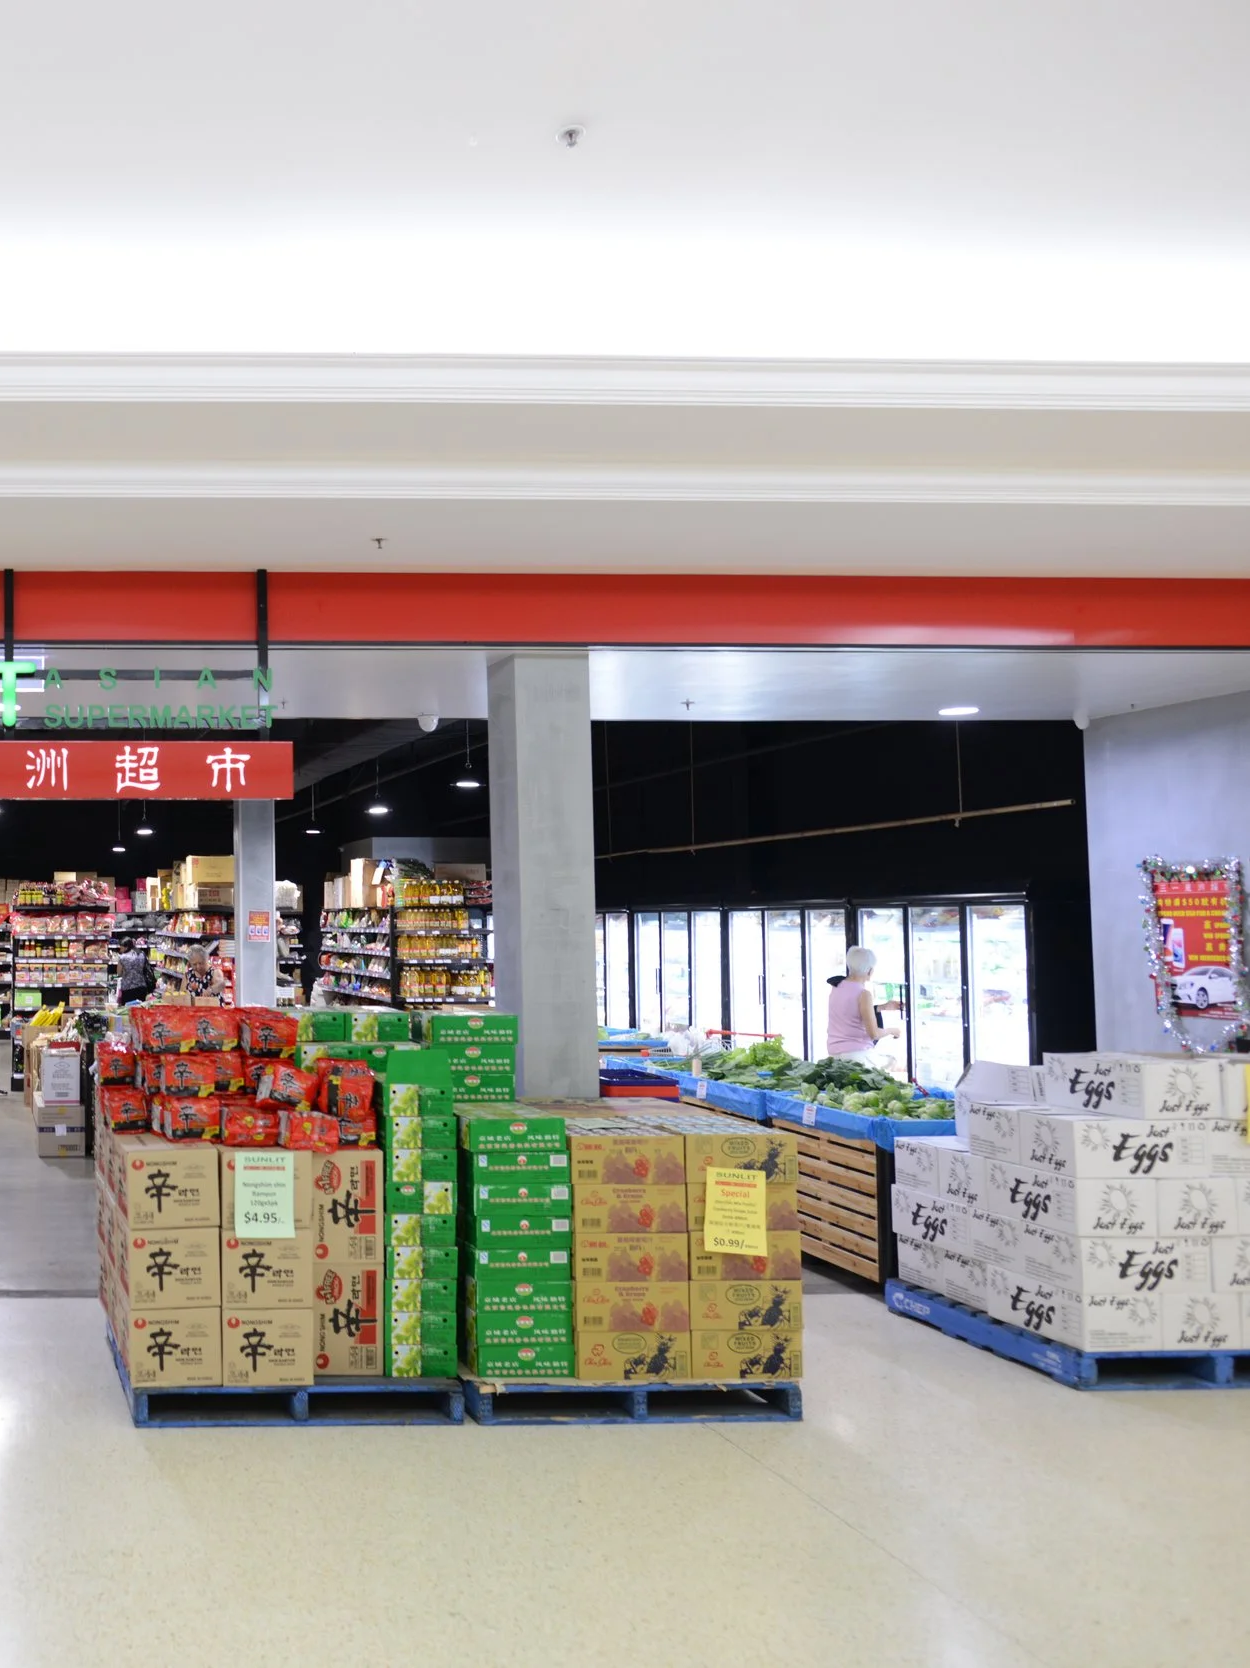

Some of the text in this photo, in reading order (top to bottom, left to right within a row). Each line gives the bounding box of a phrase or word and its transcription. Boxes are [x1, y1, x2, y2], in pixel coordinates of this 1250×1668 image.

[44, 667, 273, 692] ASIAN
[44, 705, 277, 729] SUPERMARKET
[1094, 1063, 1112, 1077] Just
[1070, 1068, 1115, 1109] Eggs
[1159, 1099, 1210, 1117] Just Eggs
[1147, 1124, 1170, 1138] Just
[1212, 1121, 1230, 1132] Just
[1031, 1149, 1066, 1171] Just Eggs
[1113, 1132, 1173, 1174] Eggs
[716, 1171, 758, 1180] SUNLIT
[1032, 1174, 1049, 1188] Just
[145, 1168, 178, 1214] 辛
[721, 1189, 750, 1198] Special
[1010, 1177, 1051, 1221] Eggs
[327, 1190, 376, 1228] 辛
[931, 1200, 945, 1214] Just
[912, 1202, 948, 1242] Eggs
[1093, 1216, 1145, 1235] Just Eggs
[1174, 1216, 1226, 1234] Just Eggs
[1153, 1241, 1174, 1255] Just
[146, 1247, 180, 1292] 辛
[239, 1248, 273, 1294] 辛
[1119, 1249, 1178, 1291] Eggs
[1035, 1285, 1053, 1299] Just
[1088, 1296, 1130, 1311] Just Eggs
[328, 1299, 377, 1338] 辛
[1011, 1285, 1055, 1331] Eggs
[147, 1328, 181, 1372] 辛
[239, 1328, 273, 1372] 辛
[1177, 1331, 1228, 1348] Just Eggs
